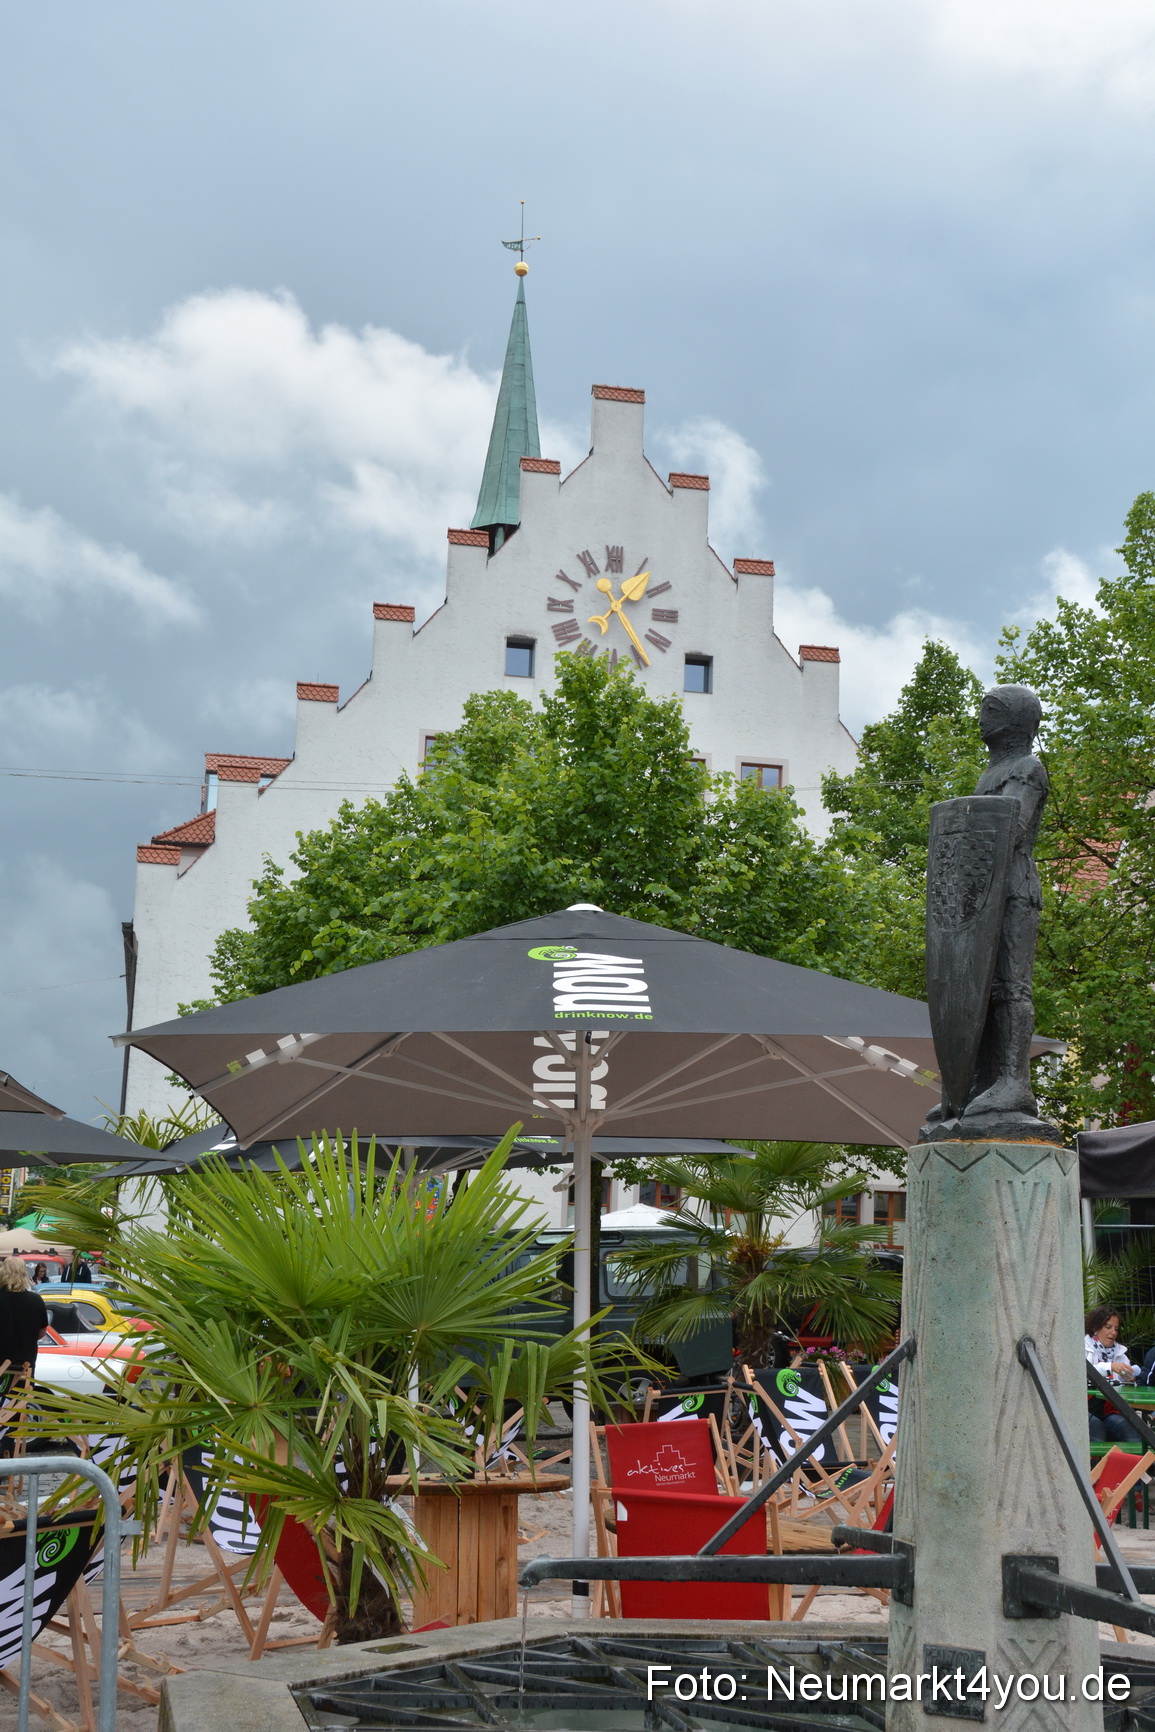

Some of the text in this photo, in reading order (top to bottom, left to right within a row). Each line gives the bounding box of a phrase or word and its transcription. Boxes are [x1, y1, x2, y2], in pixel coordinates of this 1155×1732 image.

[554, 1011, 654, 1020] drinknow.de
[627, 1459, 684, 1476] aktives
[655, 1471, 696, 1482] Neumarkt
